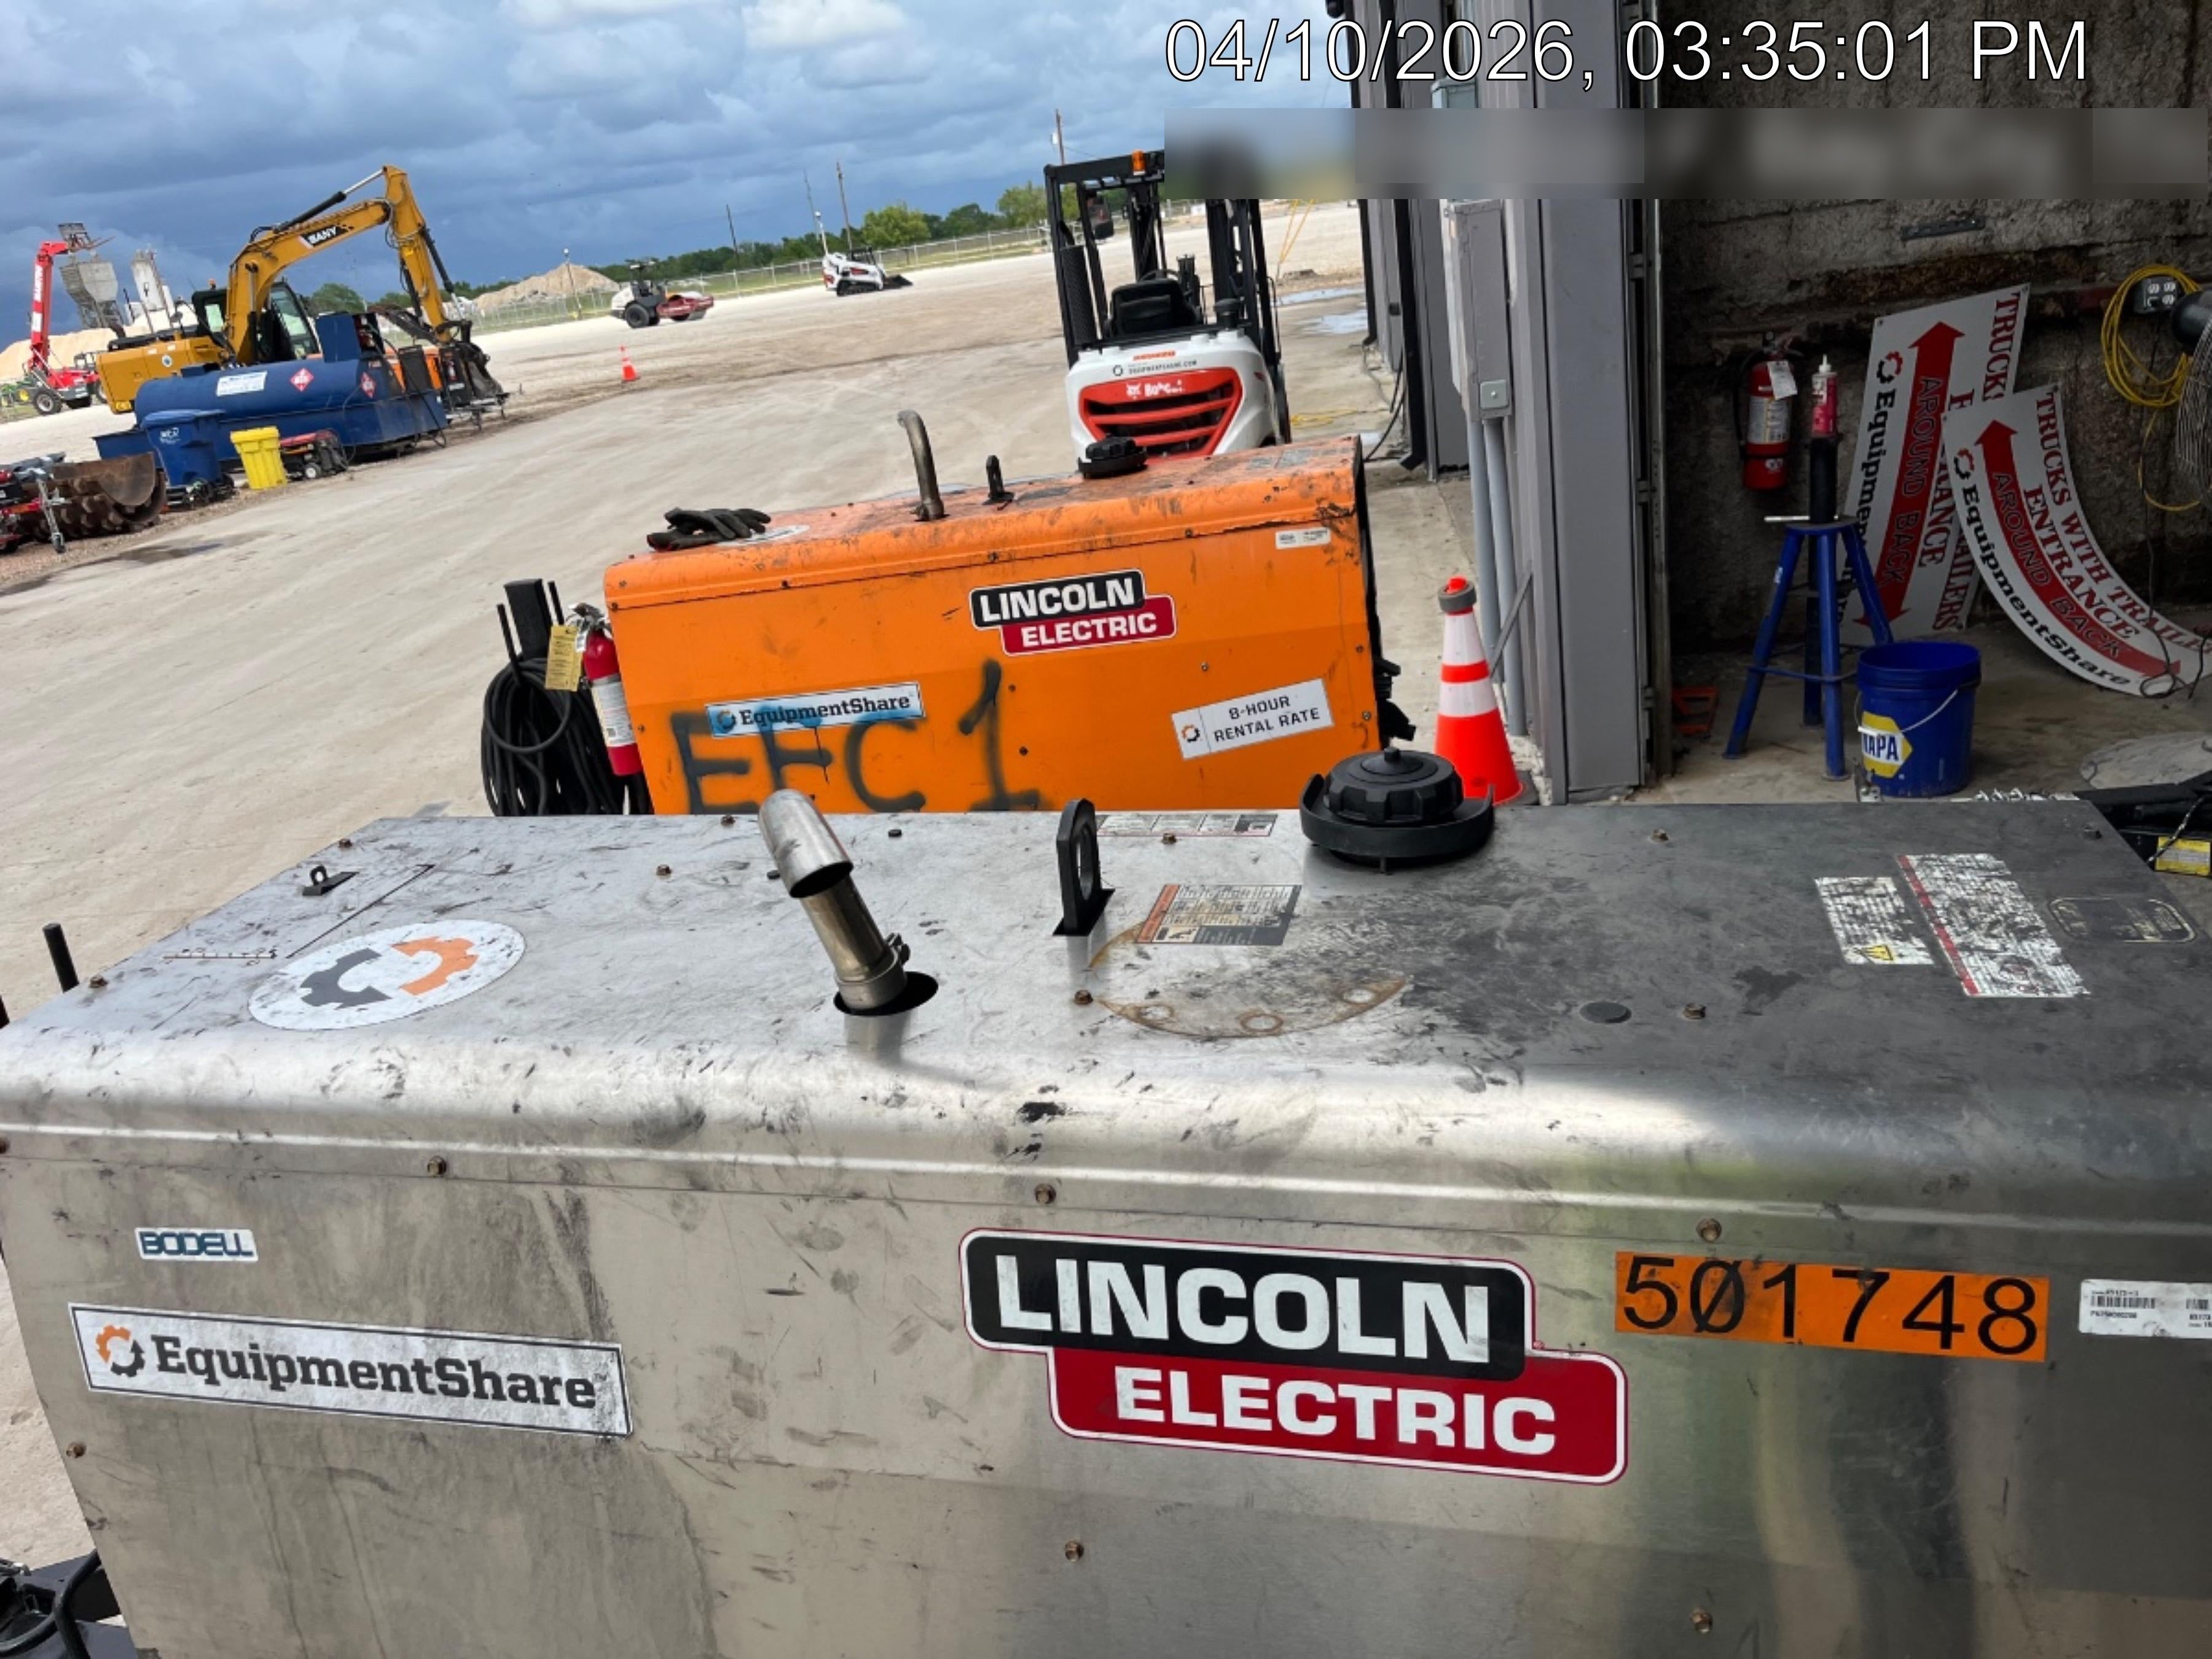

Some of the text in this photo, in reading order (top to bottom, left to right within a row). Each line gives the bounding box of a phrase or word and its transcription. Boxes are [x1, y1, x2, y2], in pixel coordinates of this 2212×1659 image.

[1885, 376, 1942, 583] AROUND BACK
[2034, 392, 2072, 506] TRUCKS
[2060, 511, 2114, 585] WITH
[979, 578, 1135, 622] LINCOLN
[1961, 484, 2132, 686] EquipmentShare
[1993, 472, 2127, 659] AROUND BACK
[2025, 484, 2140, 640] ENTRANCE
[1021, 613, 1157, 648] ELECTRIC
[739, 694, 910, 727] EquipmentShare
[1214, 708, 1320, 742] RENTAL RATE
[1228, 696, 1290, 720] 8-HOUR
[140, 1231, 254, 1258] BODELL
[995, 1254, 1489, 1363] LINCOLN
[1623, 1255, 2037, 1355] 501748
[151, 1333, 597, 1410] EquipmentShare
[1115, 1365, 1556, 1456] ELECTRIC
